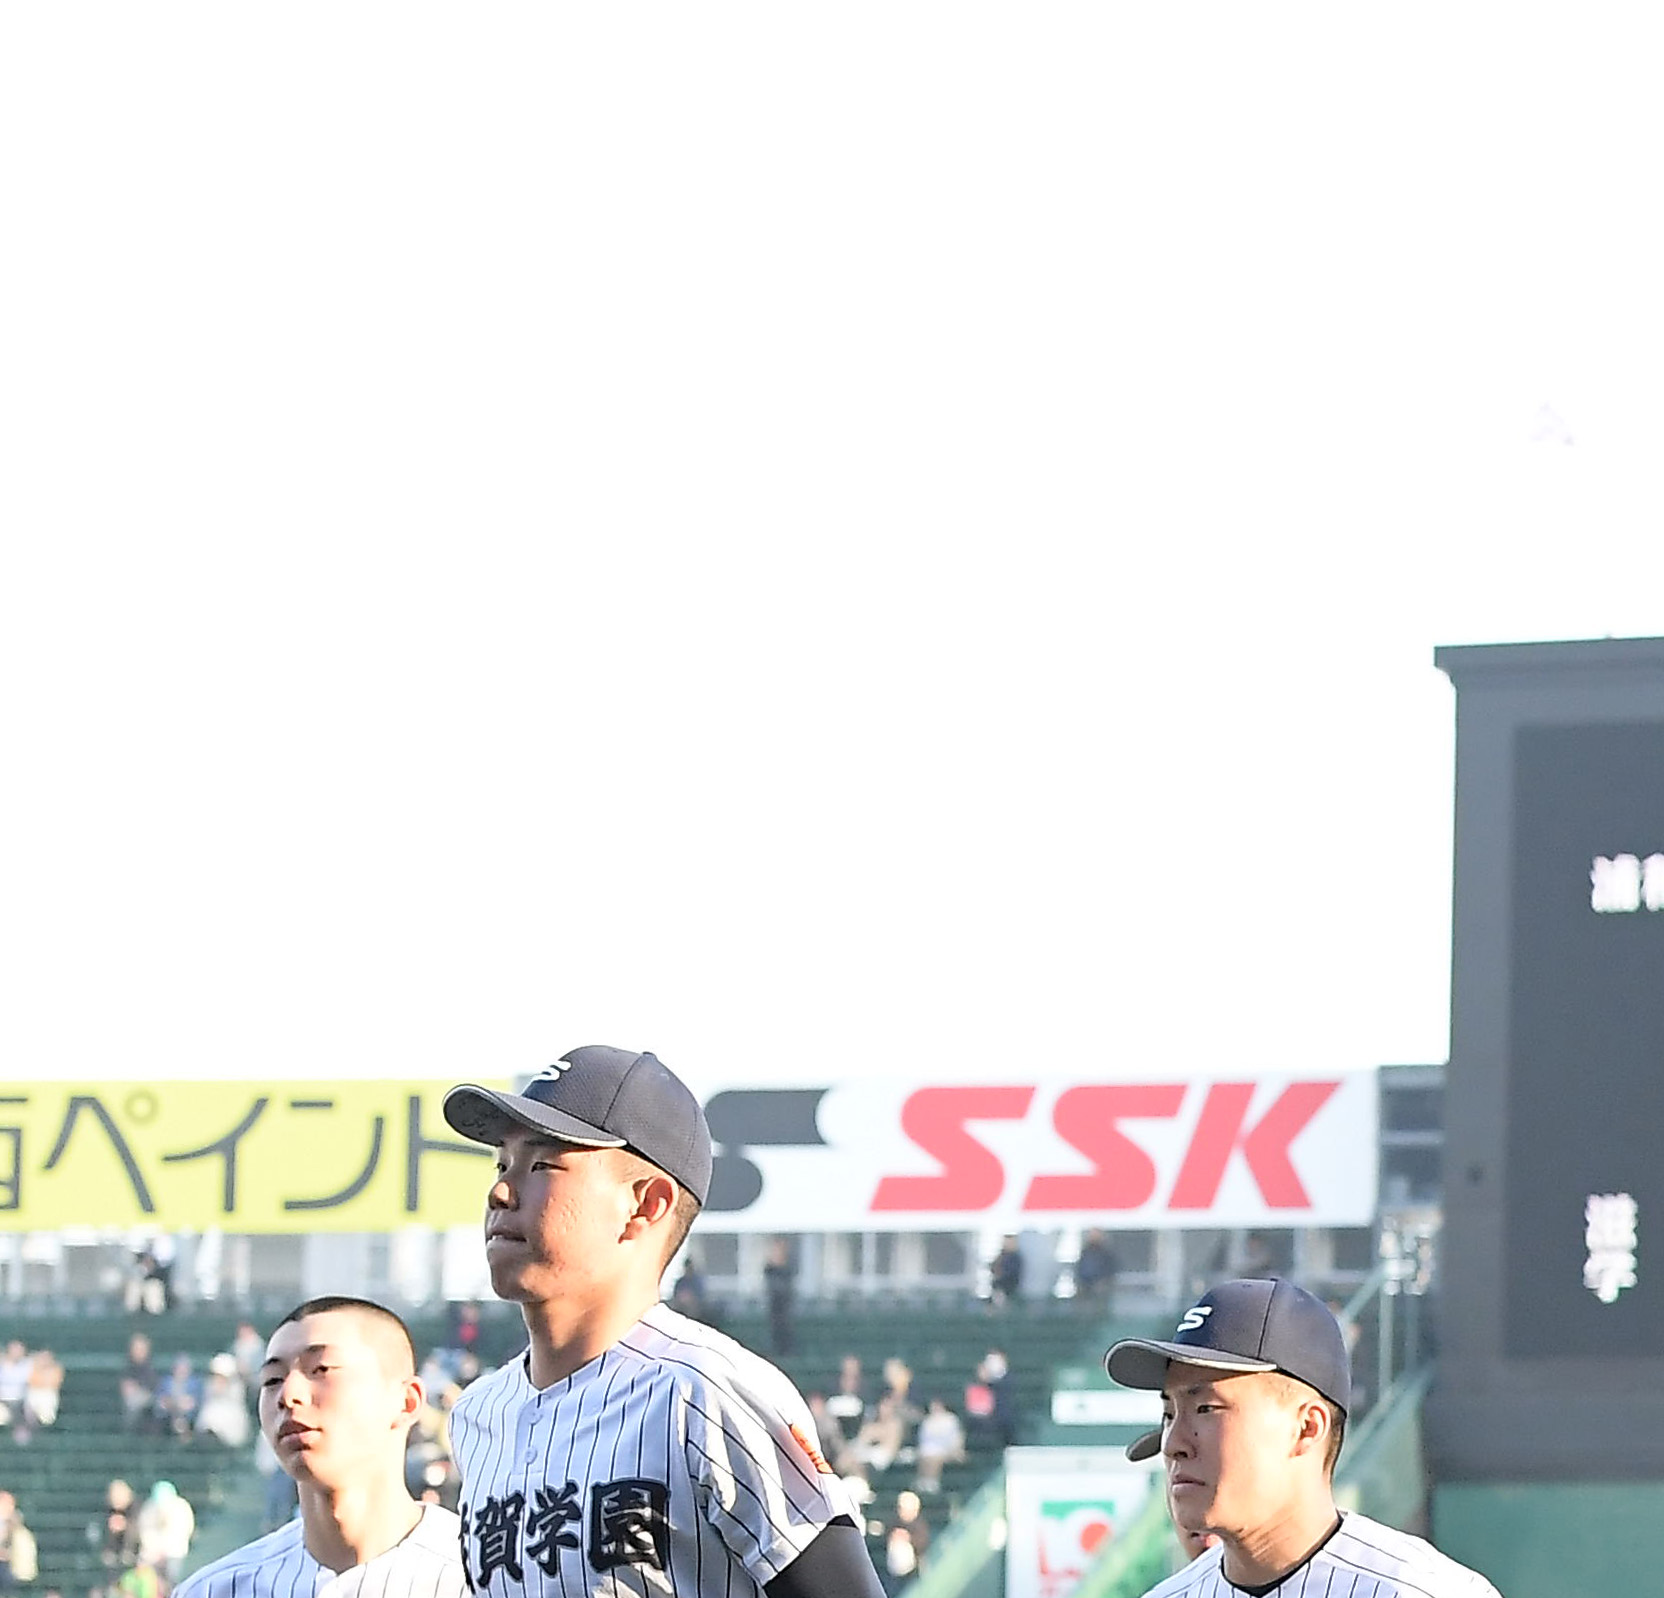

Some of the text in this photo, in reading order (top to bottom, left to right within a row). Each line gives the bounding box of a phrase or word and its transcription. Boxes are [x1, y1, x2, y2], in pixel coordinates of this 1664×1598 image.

[869, 1080, 1343, 1212] SSK
[460, 1477, 672, 1595] 賀学園
